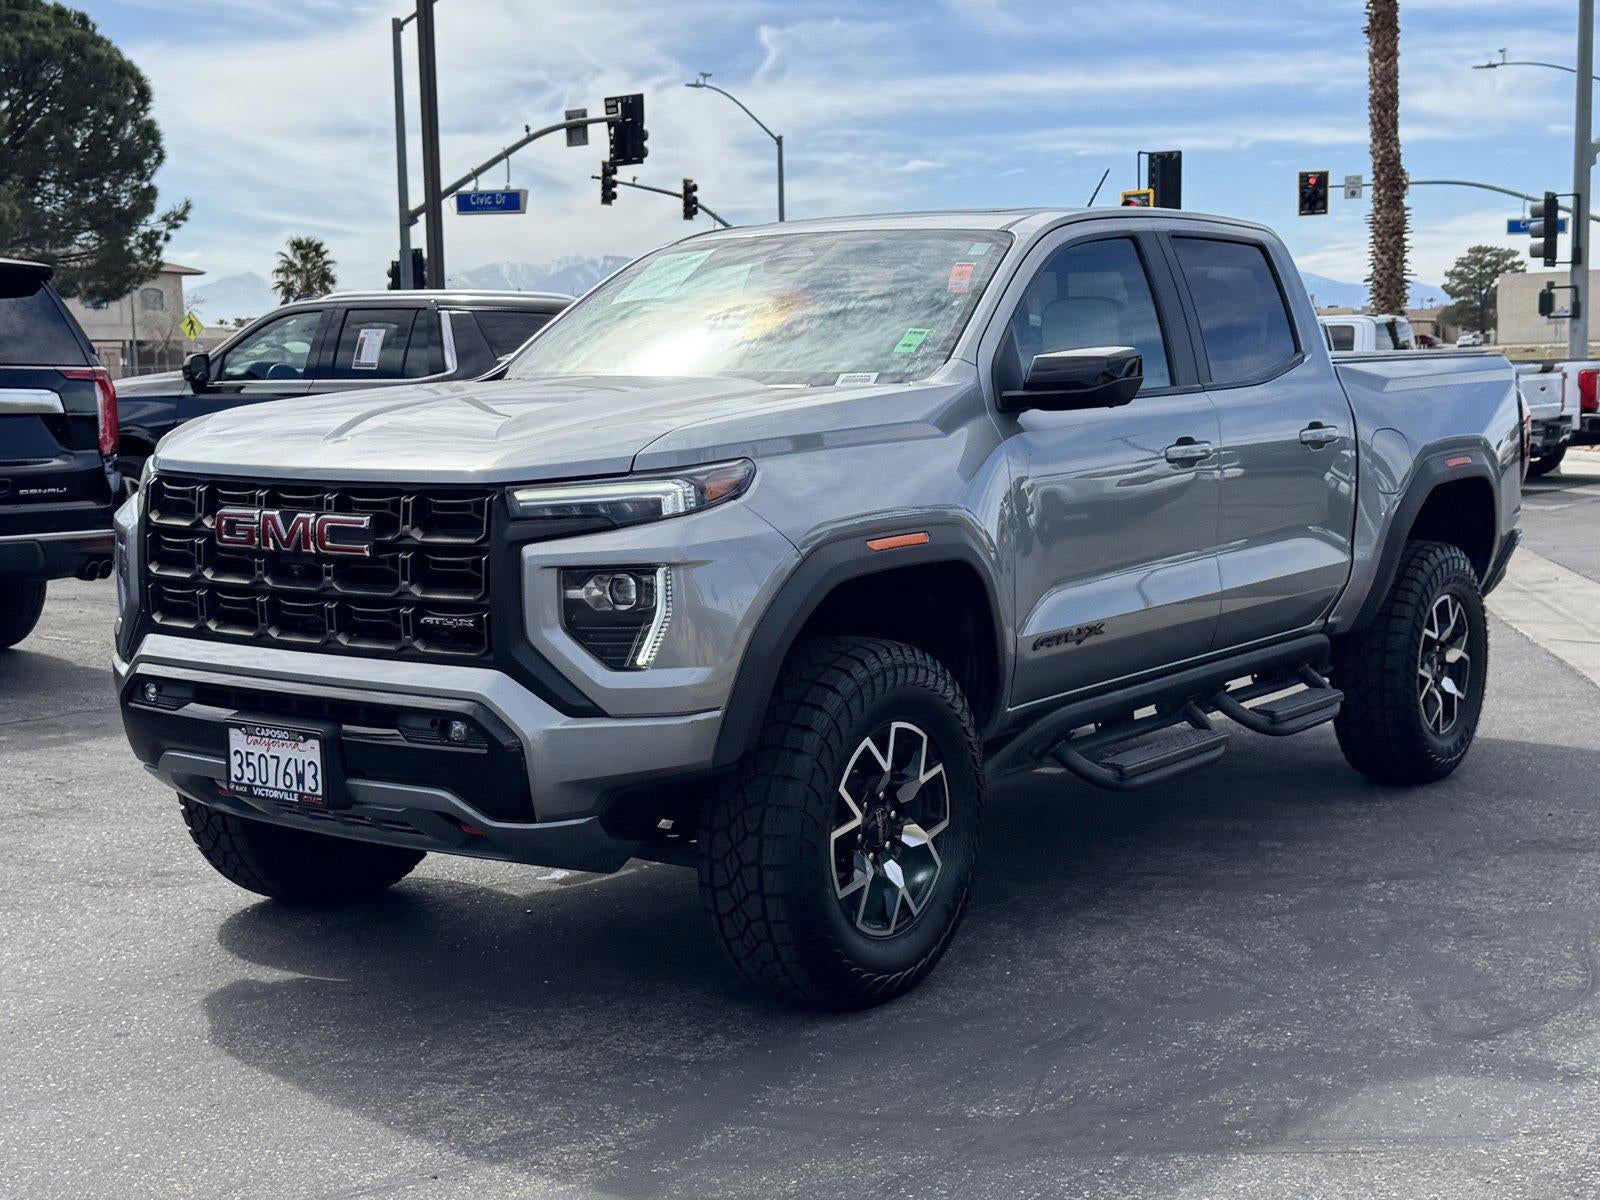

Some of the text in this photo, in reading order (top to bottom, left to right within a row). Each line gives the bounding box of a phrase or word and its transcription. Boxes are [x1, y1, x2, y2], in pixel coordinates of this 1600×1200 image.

[470, 193, 506, 205] Civic Dr
[19, 487, 67, 495] DENALI
[215, 507, 371, 557] GMC
[255, 726, 290, 740] CAPOSIO
[246, 734, 306, 753] California
[233, 749, 319, 793] 35076W3
[252, 786, 299, 802] VICTORVILLE
